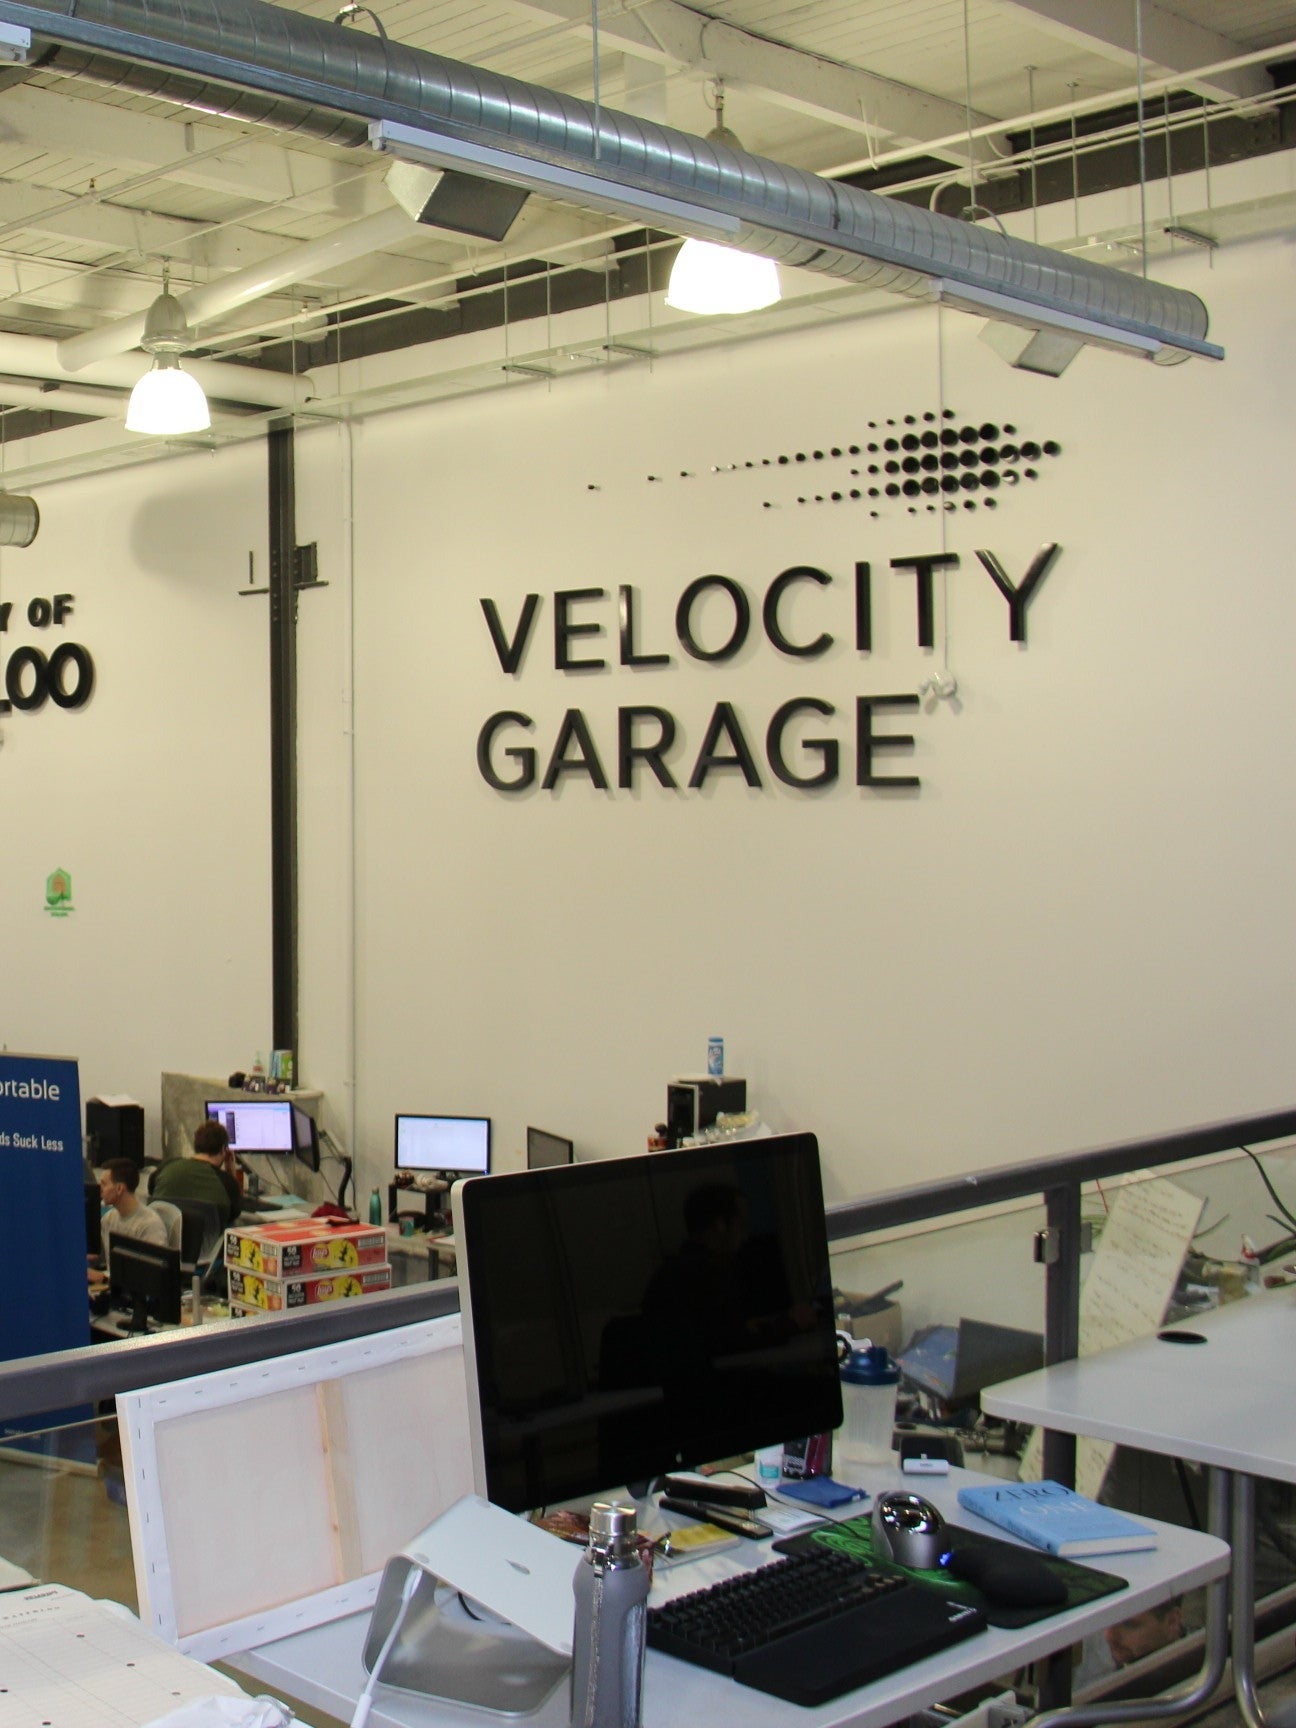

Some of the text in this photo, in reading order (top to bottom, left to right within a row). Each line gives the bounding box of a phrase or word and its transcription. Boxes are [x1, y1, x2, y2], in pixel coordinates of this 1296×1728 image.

[27, 593, 74, 628] OF
[479, 542, 1062, 675] VELOCITY
[476, 694, 920, 791] GARAGE
[13, 1132, 38, 1149] Suck
[41, 1135, 64, 1152] Less
